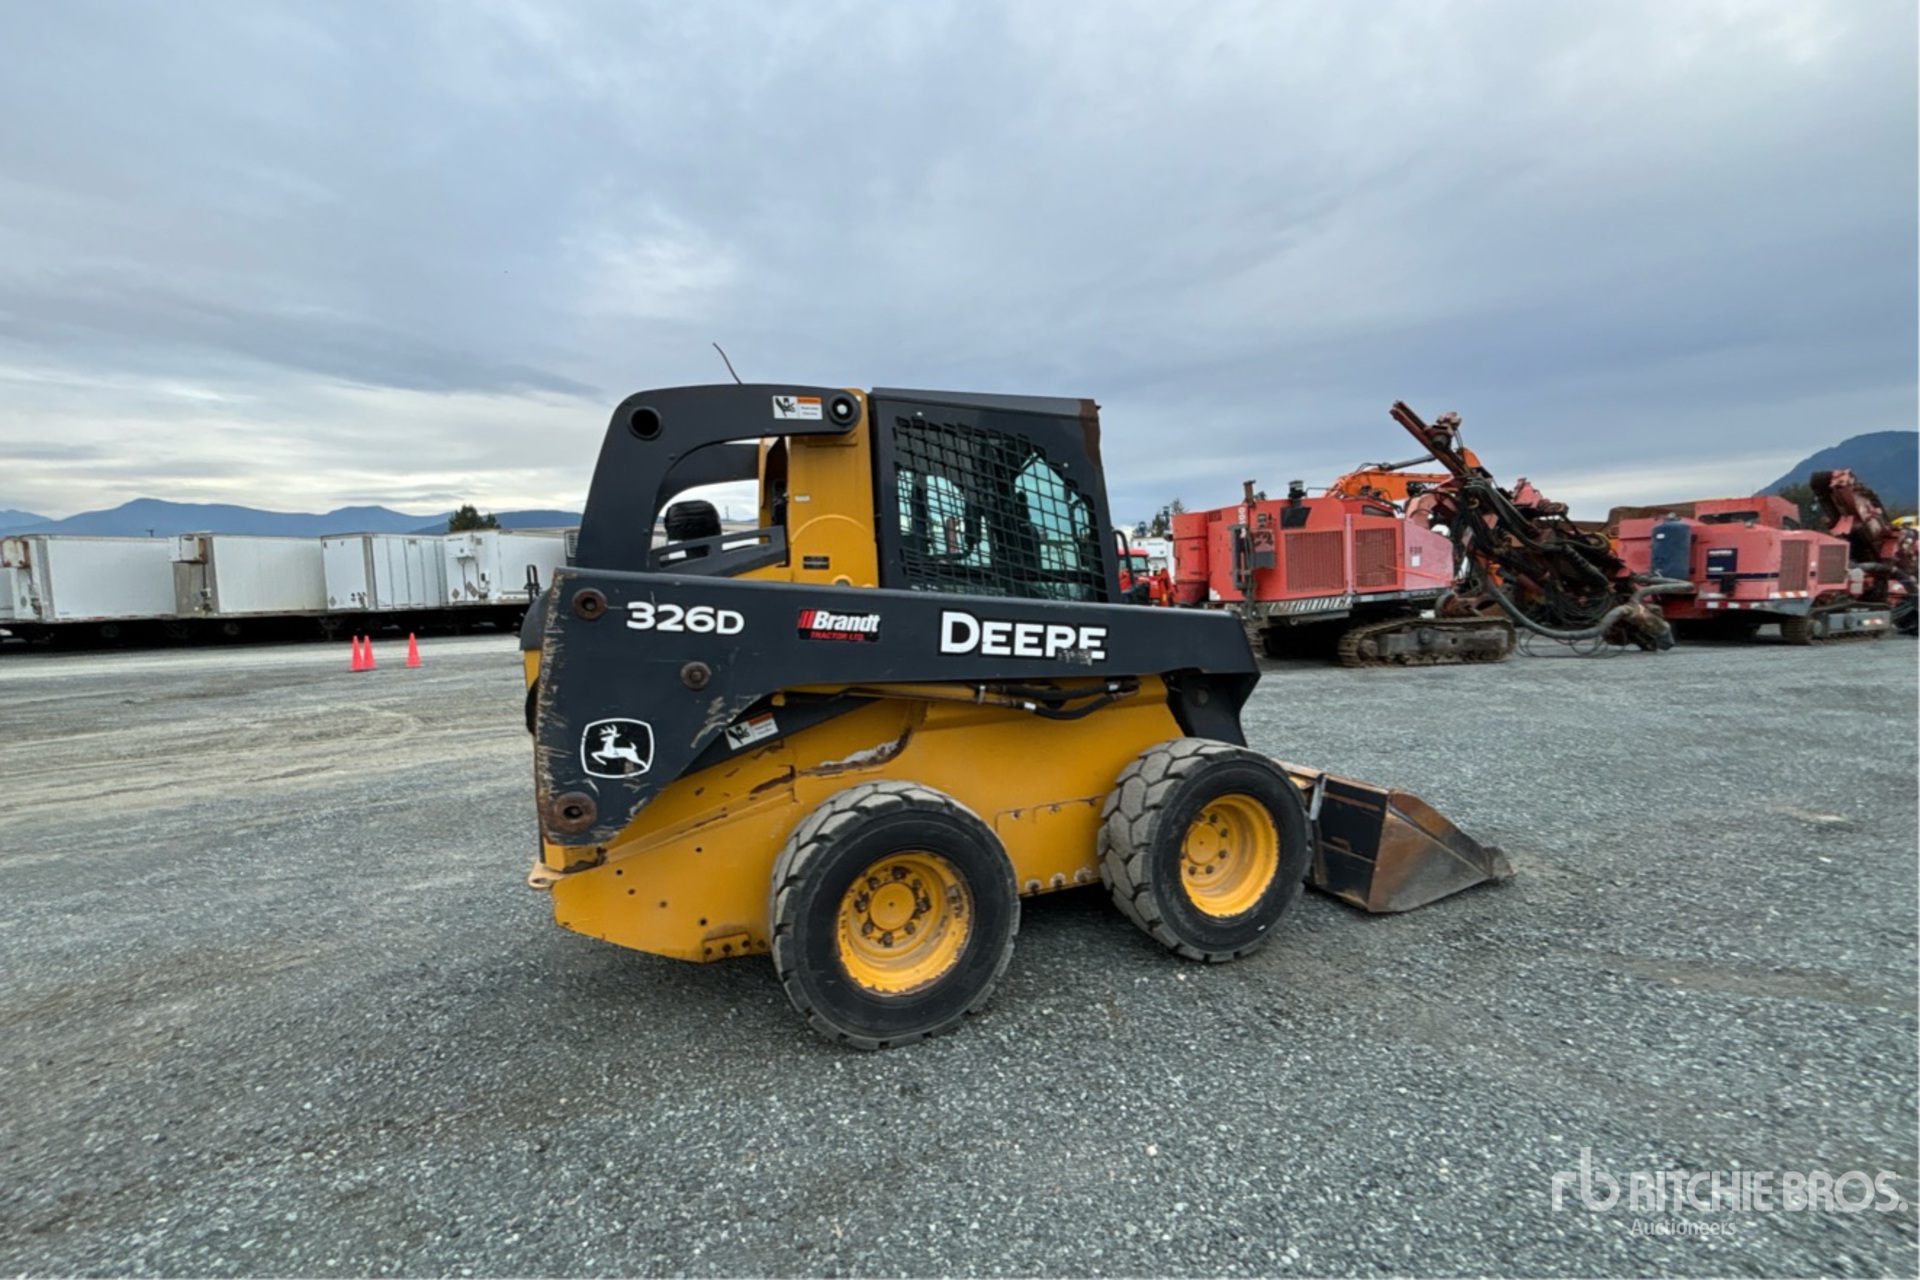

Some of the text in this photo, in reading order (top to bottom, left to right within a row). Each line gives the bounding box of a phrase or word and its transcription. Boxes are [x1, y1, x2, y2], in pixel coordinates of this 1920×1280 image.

[626, 601, 745, 635] 326D
[811, 610, 881, 632] Brandt
[940, 610, 1107, 660] DEERE
